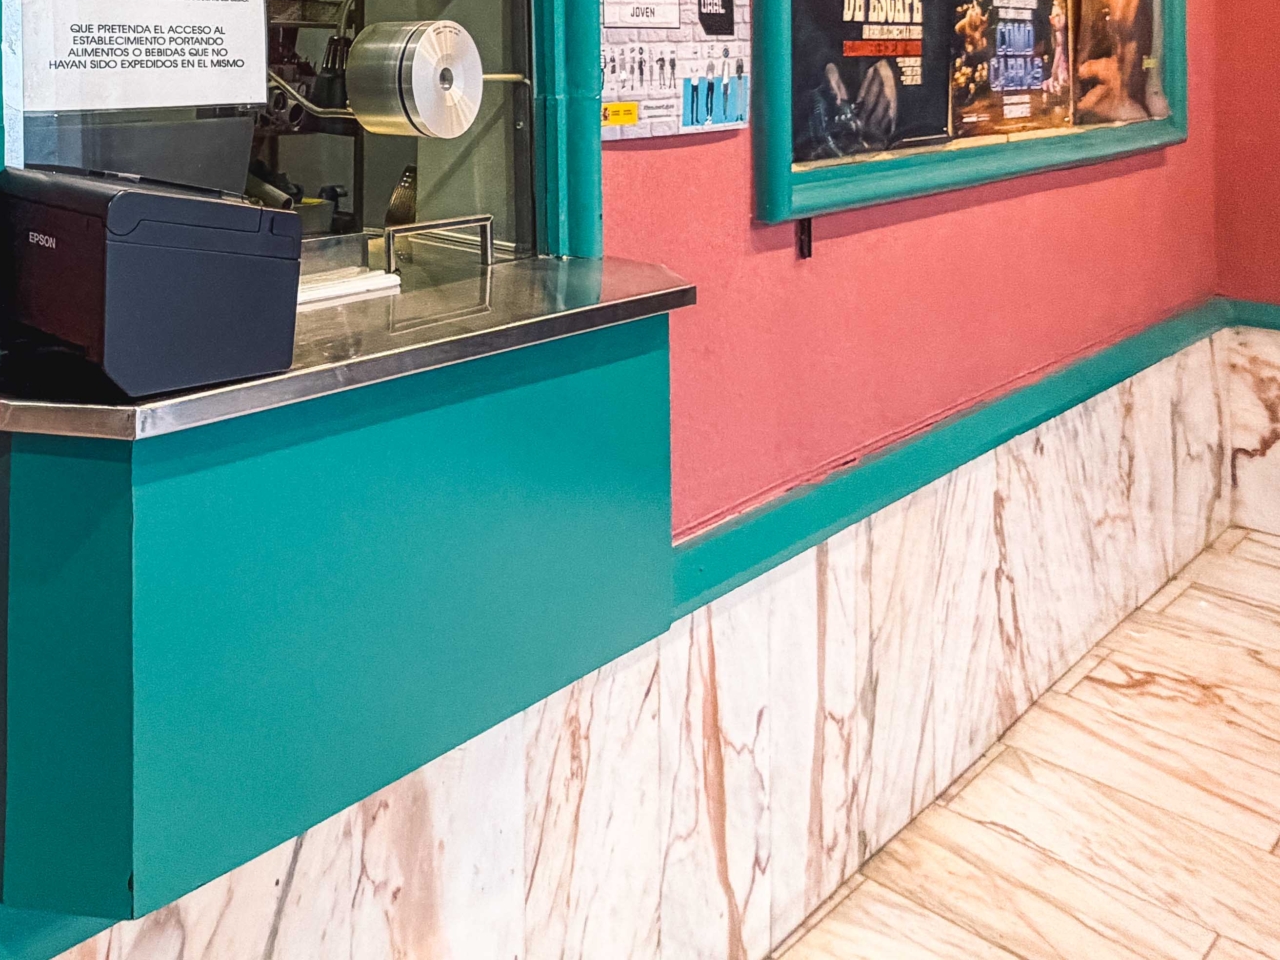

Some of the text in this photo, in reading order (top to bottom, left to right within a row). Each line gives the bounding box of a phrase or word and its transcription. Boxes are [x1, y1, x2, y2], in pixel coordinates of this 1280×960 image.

[631, 7, 655, 18] JOVEN
[70, 24, 225, 35] QUE PRETENDA EL ACCESO AL
[73, 35, 224, 47] ESTABLECIMIENTO PORTANDO
[68, 47, 228, 58] ALIMENTOS O BEBIDAS QUE NO
[48, 58, 245, 70] HAYAN SIDO EXPEDIDOS EN EL MISMO
[29, 231, 56, 249] EPSON
